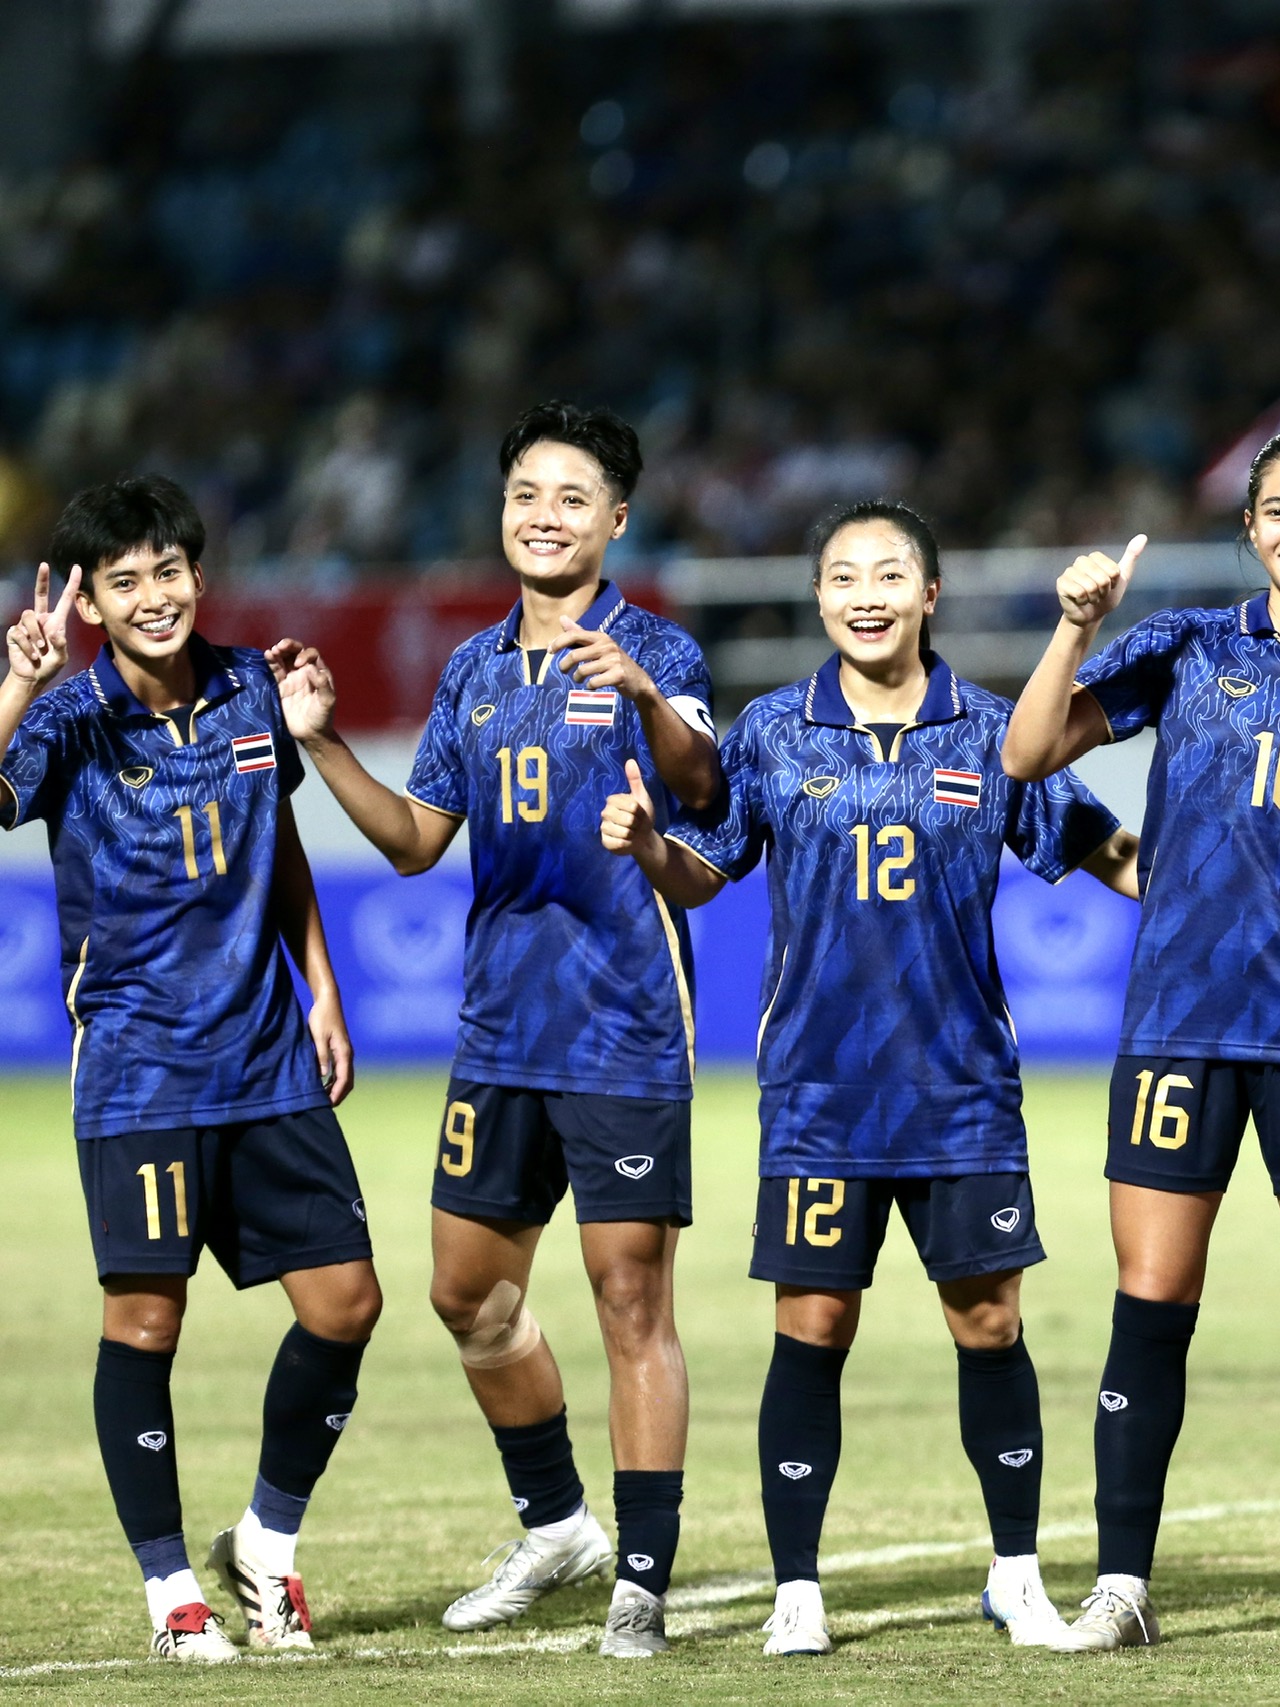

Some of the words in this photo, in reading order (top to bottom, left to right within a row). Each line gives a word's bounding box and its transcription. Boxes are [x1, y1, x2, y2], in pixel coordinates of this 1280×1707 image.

[496, 746, 549, 823] 19
[172, 801, 227, 880] 11
[849, 825, 916, 901] 12
[1130, 1069, 1191, 1150] 16
[136, 1161, 189, 1240] 11
[786, 1178, 844, 1247] 12
